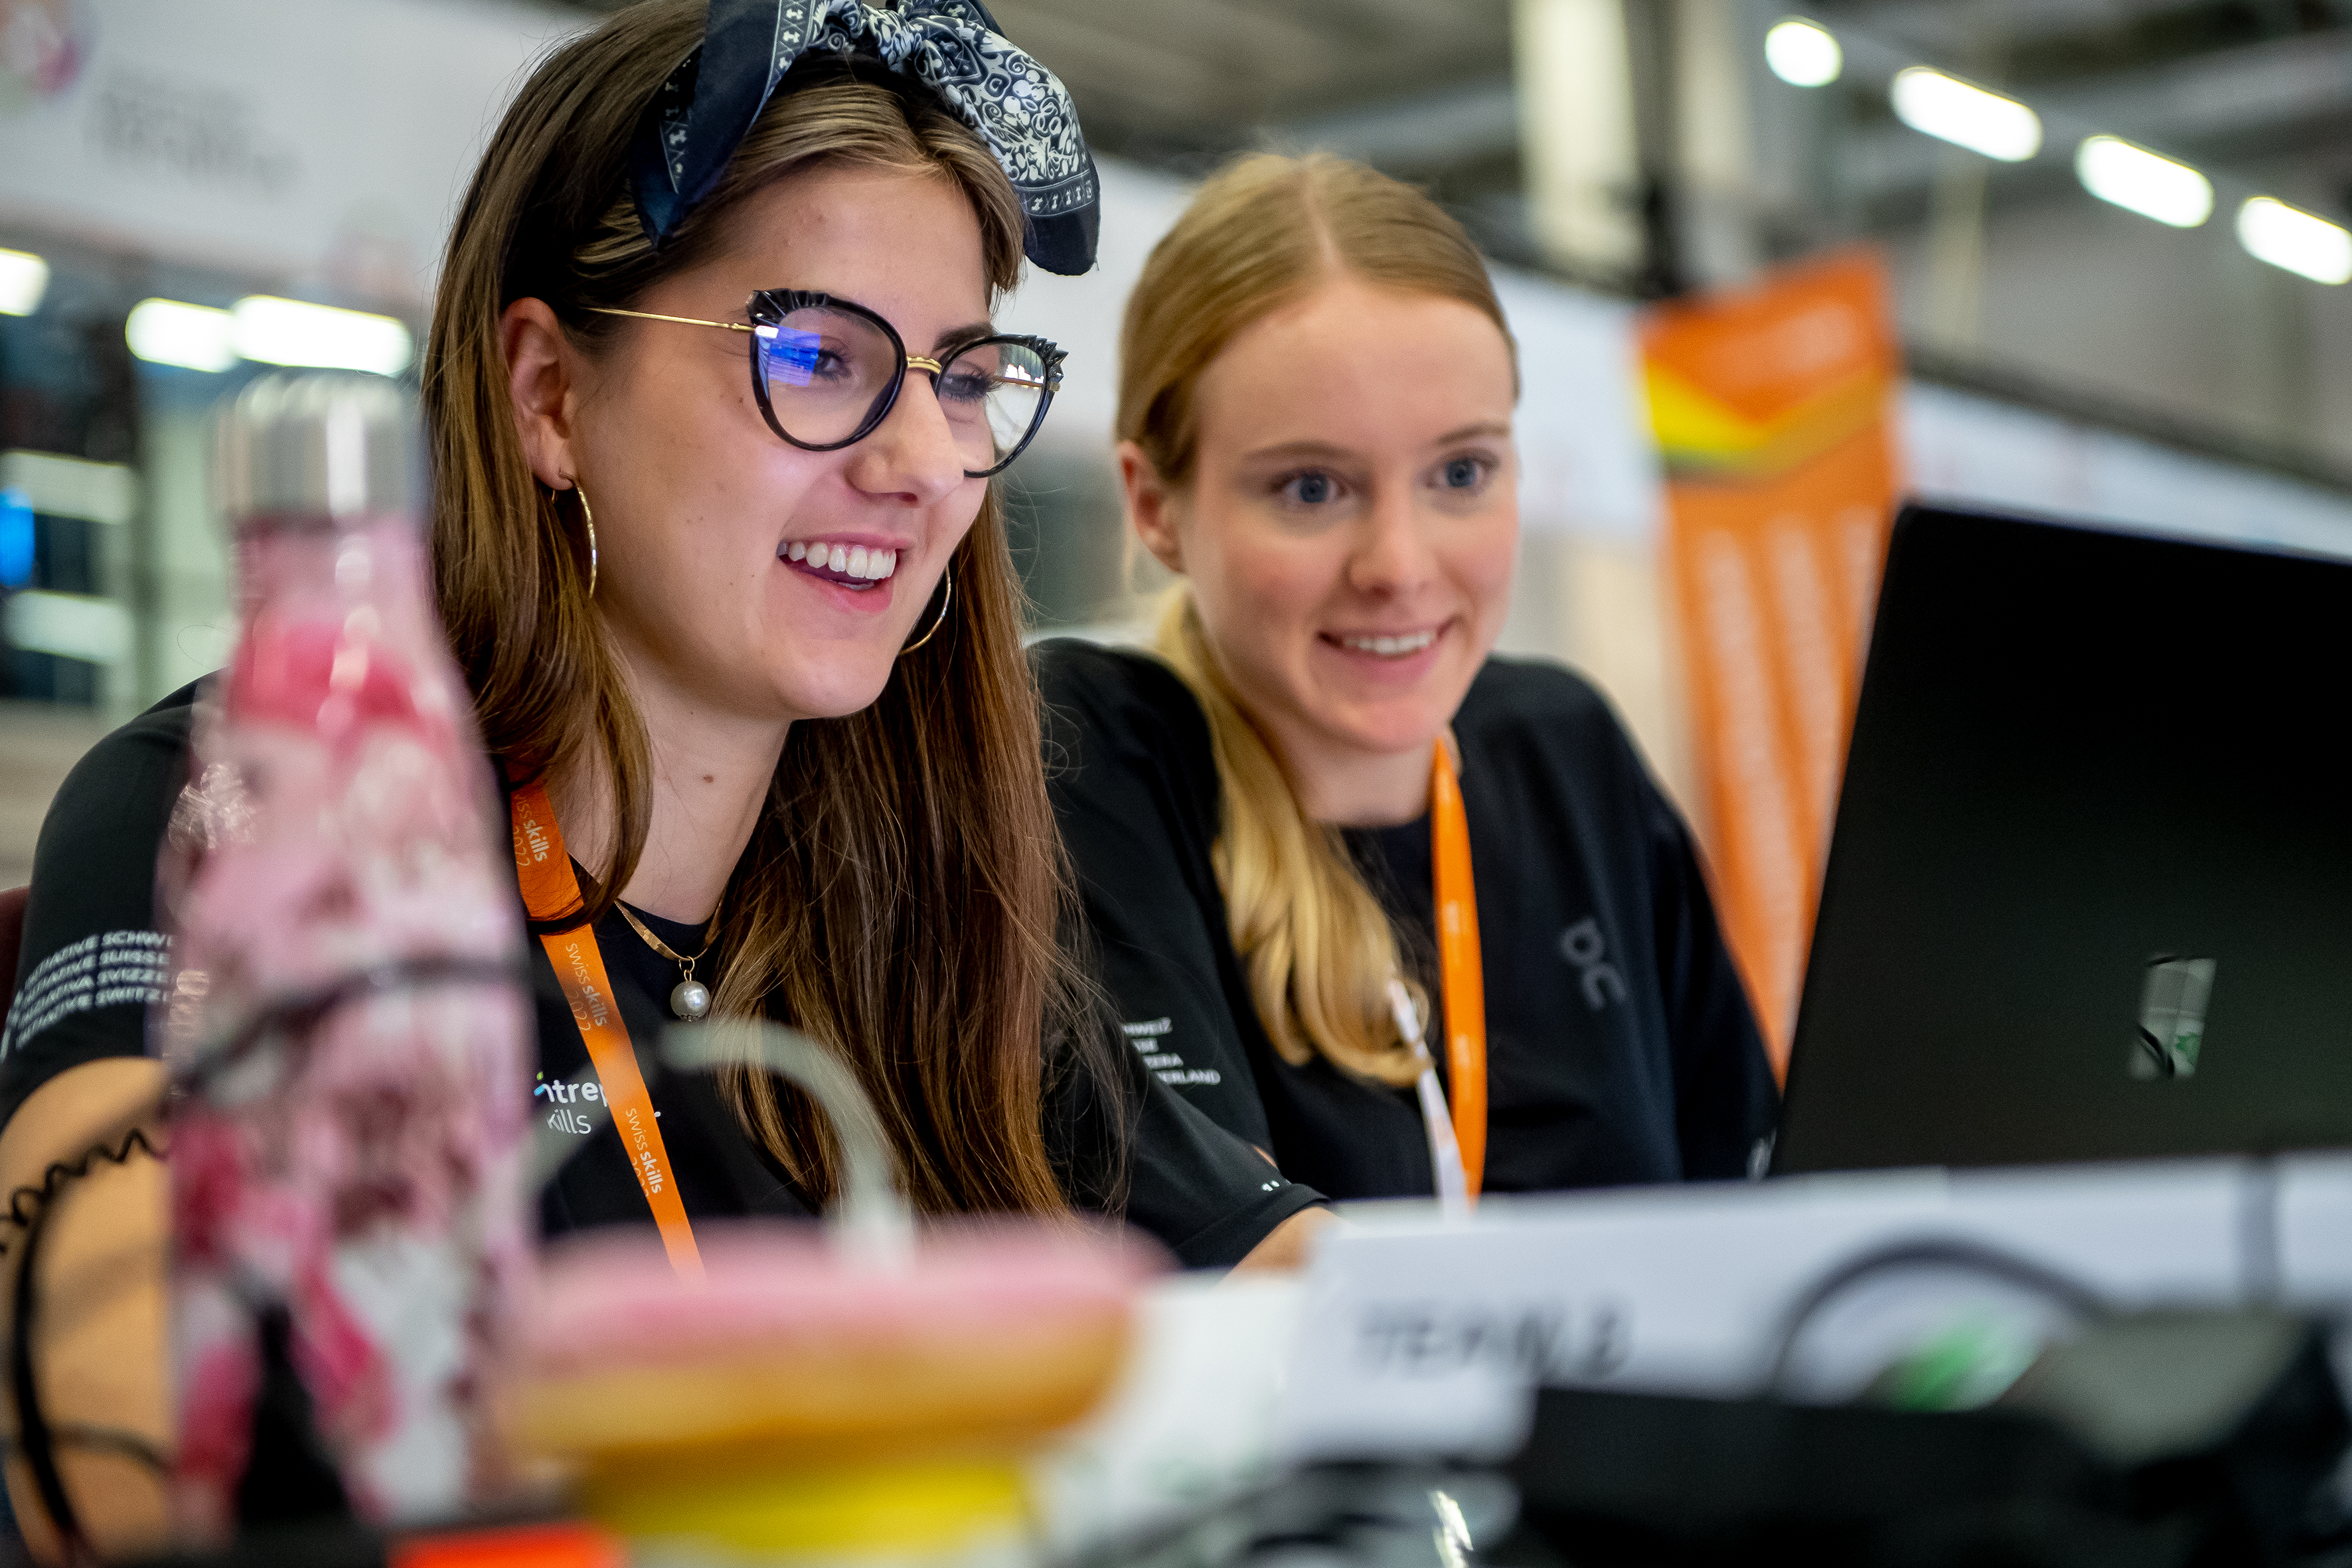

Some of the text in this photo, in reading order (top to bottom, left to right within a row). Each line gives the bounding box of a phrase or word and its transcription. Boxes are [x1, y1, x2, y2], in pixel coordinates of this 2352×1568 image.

[523, 819, 550, 862] skills
[566, 943, 608, 1026] swiss skills
[547, 1109, 592, 1135] kills
[625, 1108, 648, 1150] swiss
[640, 1150, 664, 1194] skills
